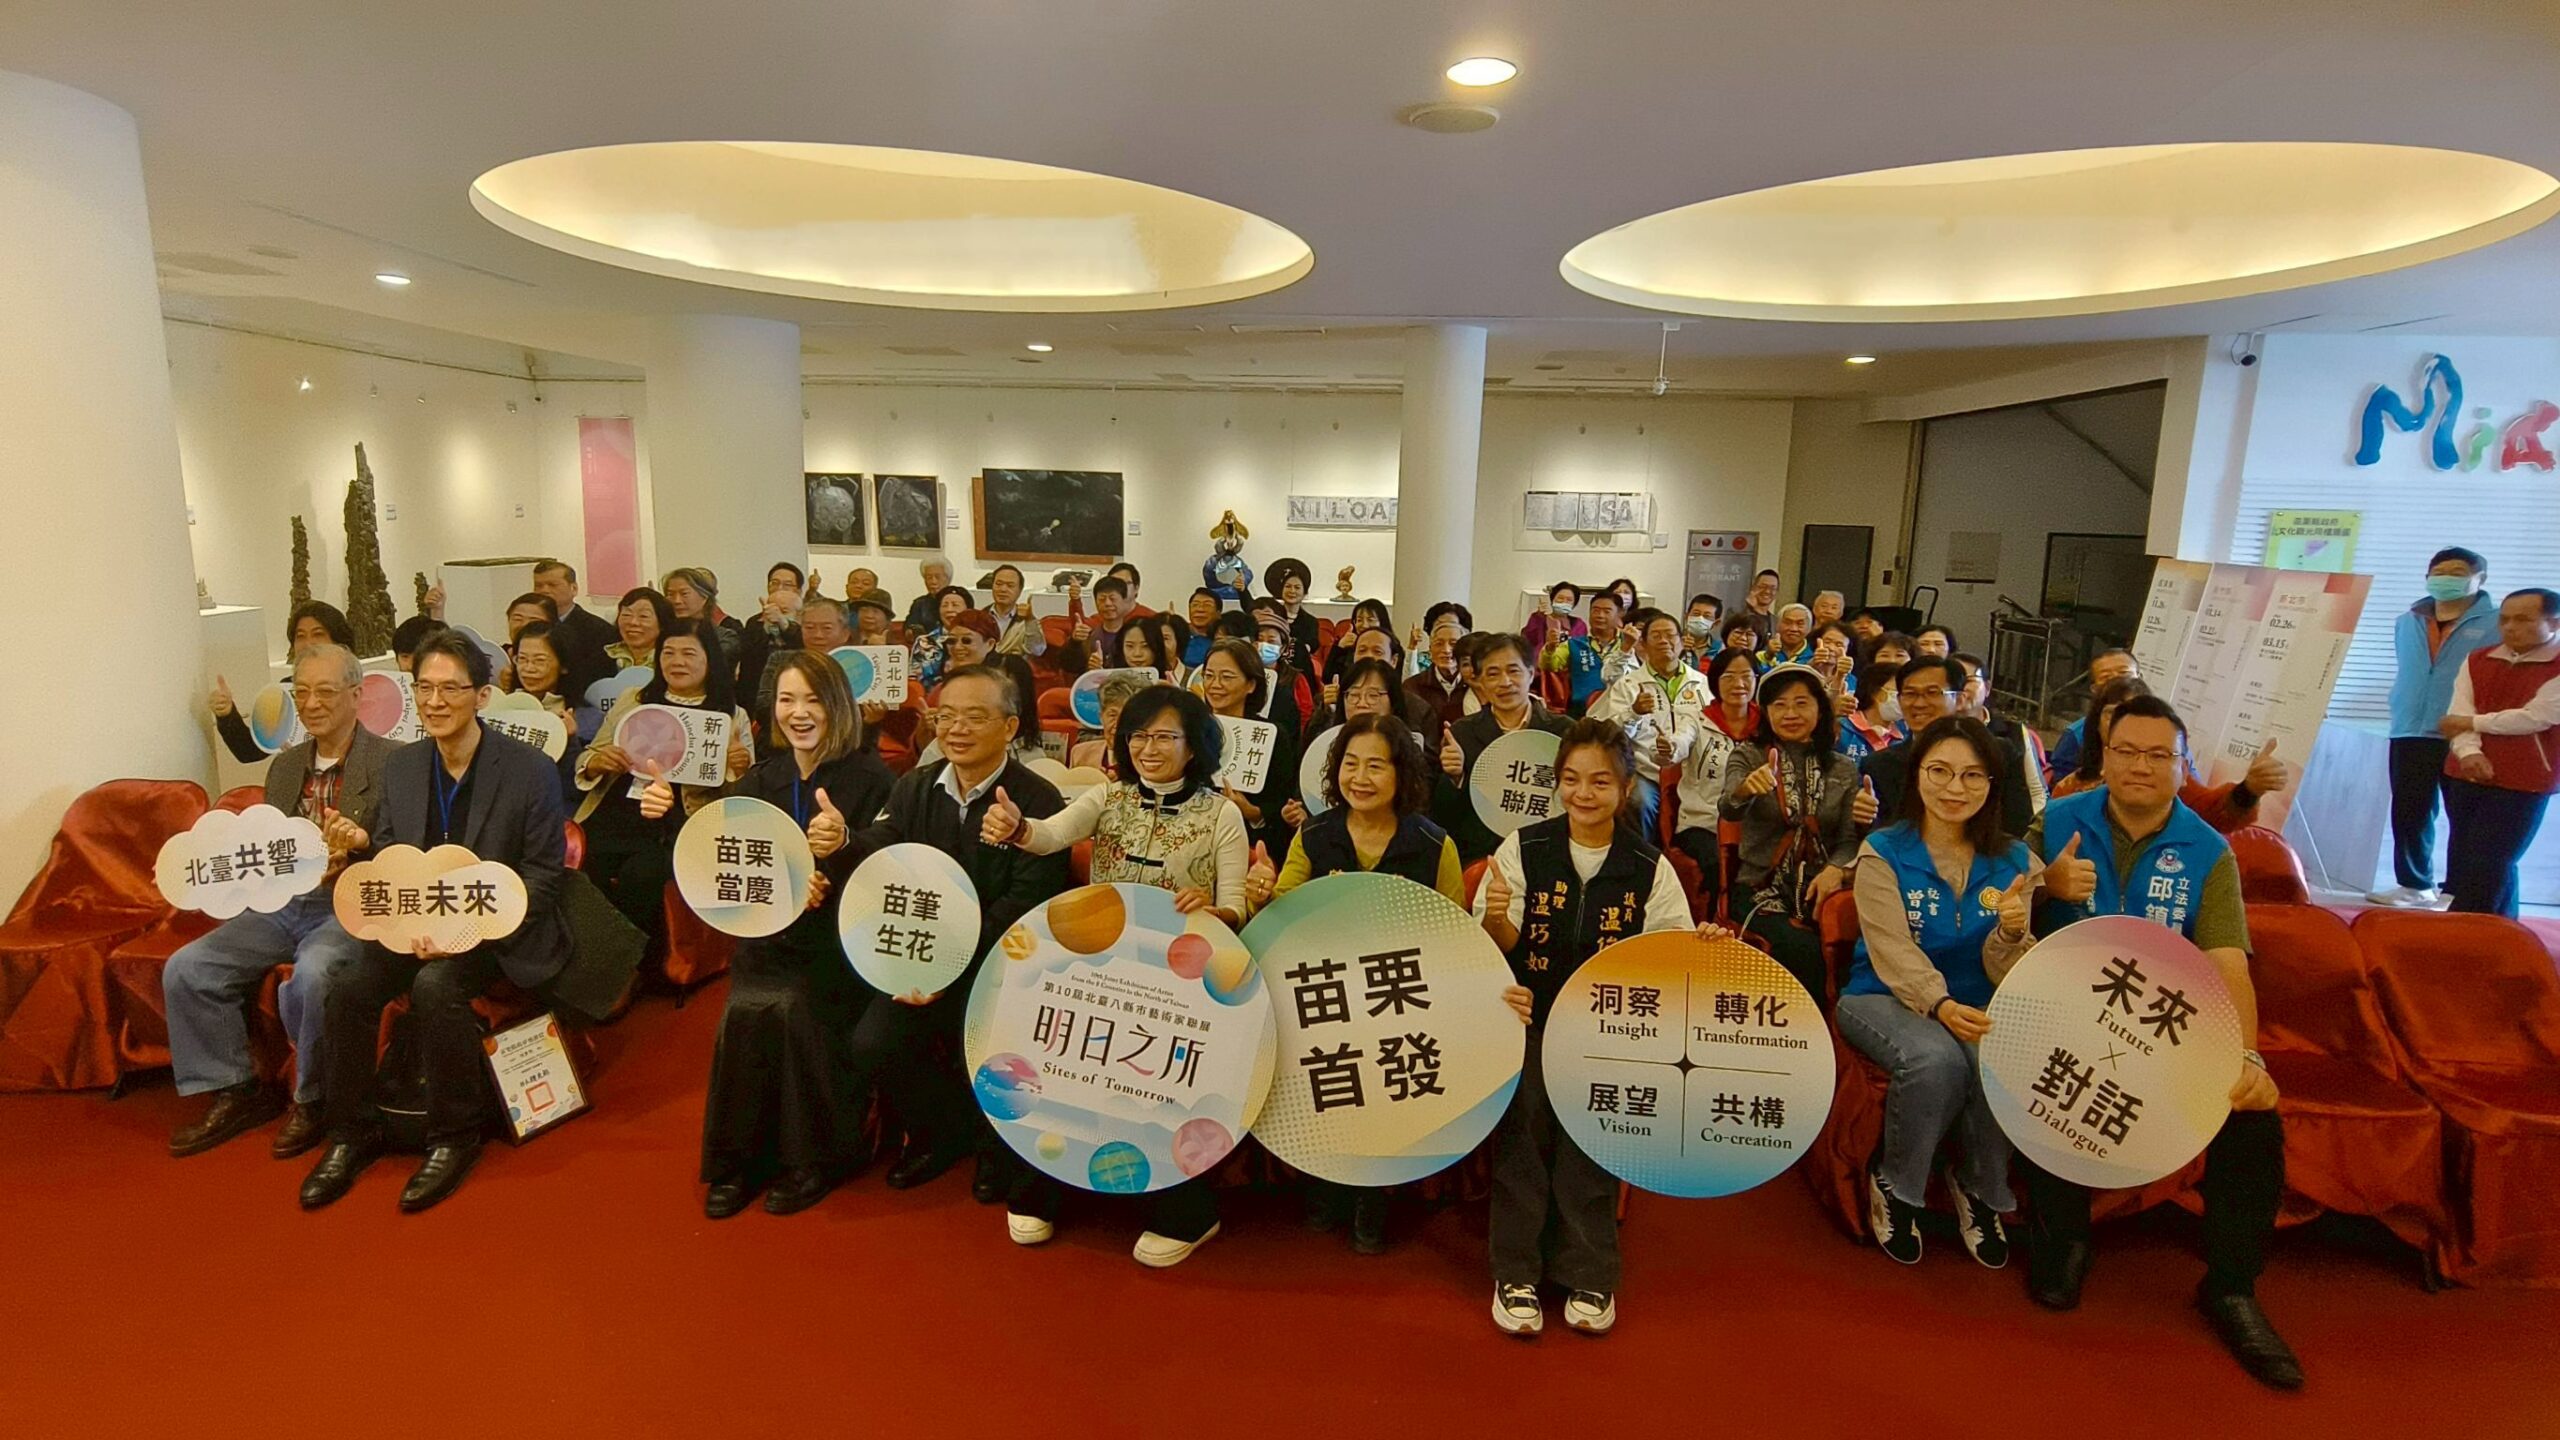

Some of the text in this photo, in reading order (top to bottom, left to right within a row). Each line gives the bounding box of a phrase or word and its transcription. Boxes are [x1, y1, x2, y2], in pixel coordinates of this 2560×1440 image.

[886, 649, 902, 699] 台北市
[698, 716, 723, 781] 新竹縣
[1241, 726, 1270, 788] 新竹市
[1505, 760, 1555, 788] 北臺
[1500, 789, 1550, 818] 聯展
[185, 838, 298, 886] 北臺共響
[714, 835, 773, 867] 苗栗
[359, 880, 499, 916] 藝展未來
[715, 872, 774, 905] 當慶
[883, 883, 942, 921] 苗筆
[1553, 880, 1568, 909] 助理
[875, 923, 936, 963] 生花
[1526, 892, 1551, 971] 溫巧如
[1043, 981, 1212, 1032] 第10屆北臺八縣市藝術家聯展
[1284, 947, 1431, 1029] 苗栗
[1589, 983, 1661, 1019] 洞察
[2091, 955, 2200, 1047] 未來
[1598, 1019, 1659, 1040] Insight
[1713, 991, 1789, 1029] 轉化
[1033, 1004, 1207, 1088] 明日之所
[1693, 1026, 1809, 1050] Transformation
[2095, 1010, 2155, 1057] Future
[1042, 1061, 1176, 1104] Sites of Tomorrow
[1300, 1031, 1446, 1113] 首發
[1586, 1083, 1659, 1118] 展望
[1711, 1093, 1786, 1129] 共構
[2030, 1046, 2144, 1147] 對話
[1597, 1118, 1652, 1137] Vision
[1700, 1128, 1793, 1150] Co-creation
[2027, 1097, 2109, 1160] Dialogue
